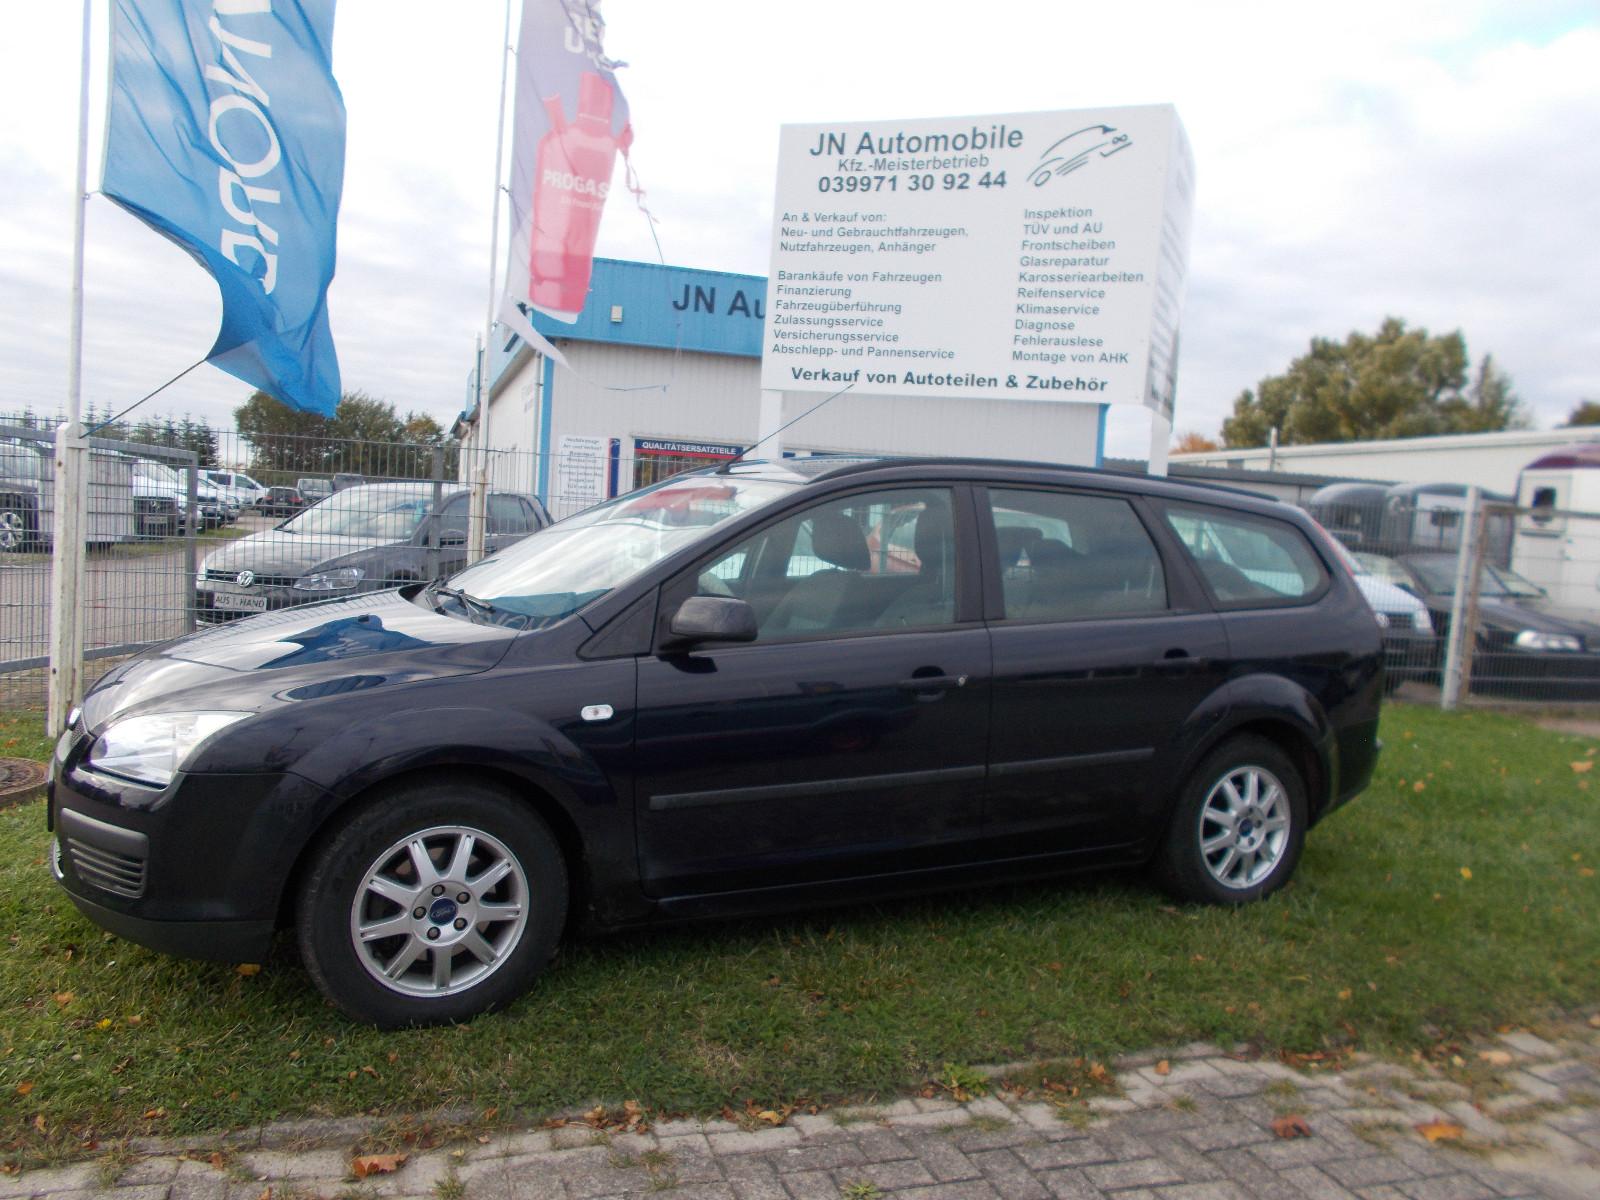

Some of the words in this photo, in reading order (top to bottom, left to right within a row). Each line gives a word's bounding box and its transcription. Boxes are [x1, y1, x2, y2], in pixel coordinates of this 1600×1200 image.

[810, 132, 847, 156] JN
[855, 125, 1024, 155] Automobile
[837, 154, 990, 172] Kfz.-Meisterbetrieb
[818, 176, 898, 193] 039971
[908, 175, 934, 191] 30
[943, 173, 970, 190] 92
[978, 171, 1007, 189] 44
[782, 212, 798, 223] An
[801, 212, 809, 223] &
[814, 212, 859, 223] Verkauf
[861, 213, 887, 223] von:
[1024, 206, 1092, 220] Inspektion
[781, 226, 808, 237] Neu-
[811, 227, 833, 237] und
[837, 225, 969, 240] Gebrauchtfahrzeugen,
[1024, 223, 1050, 236] TÜV
[1053, 223, 1078, 234] und
[1083, 222, 1103, 234] AU
[780, 241, 874, 254] Nutzfahrzeugen,
[878, 241, 936, 254] Anhänger
[1022, 238, 1115, 251] Frontscheiben
[1020, 255, 1110, 270] Glasreparatur
[778, 270, 844, 282] Barankäufe
[847, 272, 869, 283] von
[872, 272, 942, 285] Fahrzeugen
[1019, 271, 1144, 283] Karosseriearbeiten
[672, 284, 716, 314] JN
[777, 285, 851, 299] Finanzierung
[1017, 287, 1105, 299] Reifenservice
[776, 300, 902, 315] Fahrzeugüberführung
[1016, 303, 1099, 315] Klimaservice
[774, 315, 883, 330] Zulassungsservice
[1015, 319, 1075, 333] Diagnose
[774, 330, 899, 344] Versicherungsservice
[1014, 335, 1103, 347] Fehlerauslese
[772, 343, 838, 358] Abschlepp-
[841, 345, 863, 356] und
[867, 347, 954, 359] Pannenservice
[1012, 350, 1067, 364] Montage
[1071, 352, 1095, 362] von
[1099, 351, 1129, 363] AHK
[791, 367, 860, 383] Verkauf
[866, 371, 897, 383] von
[903, 372, 998, 388] Autoteilen
[1006, 375, 1018, 388] &
[1026, 375, 1108, 391] Zubehör
[641, 441, 737, 455] QUALITÄTSERSATZTEILE
